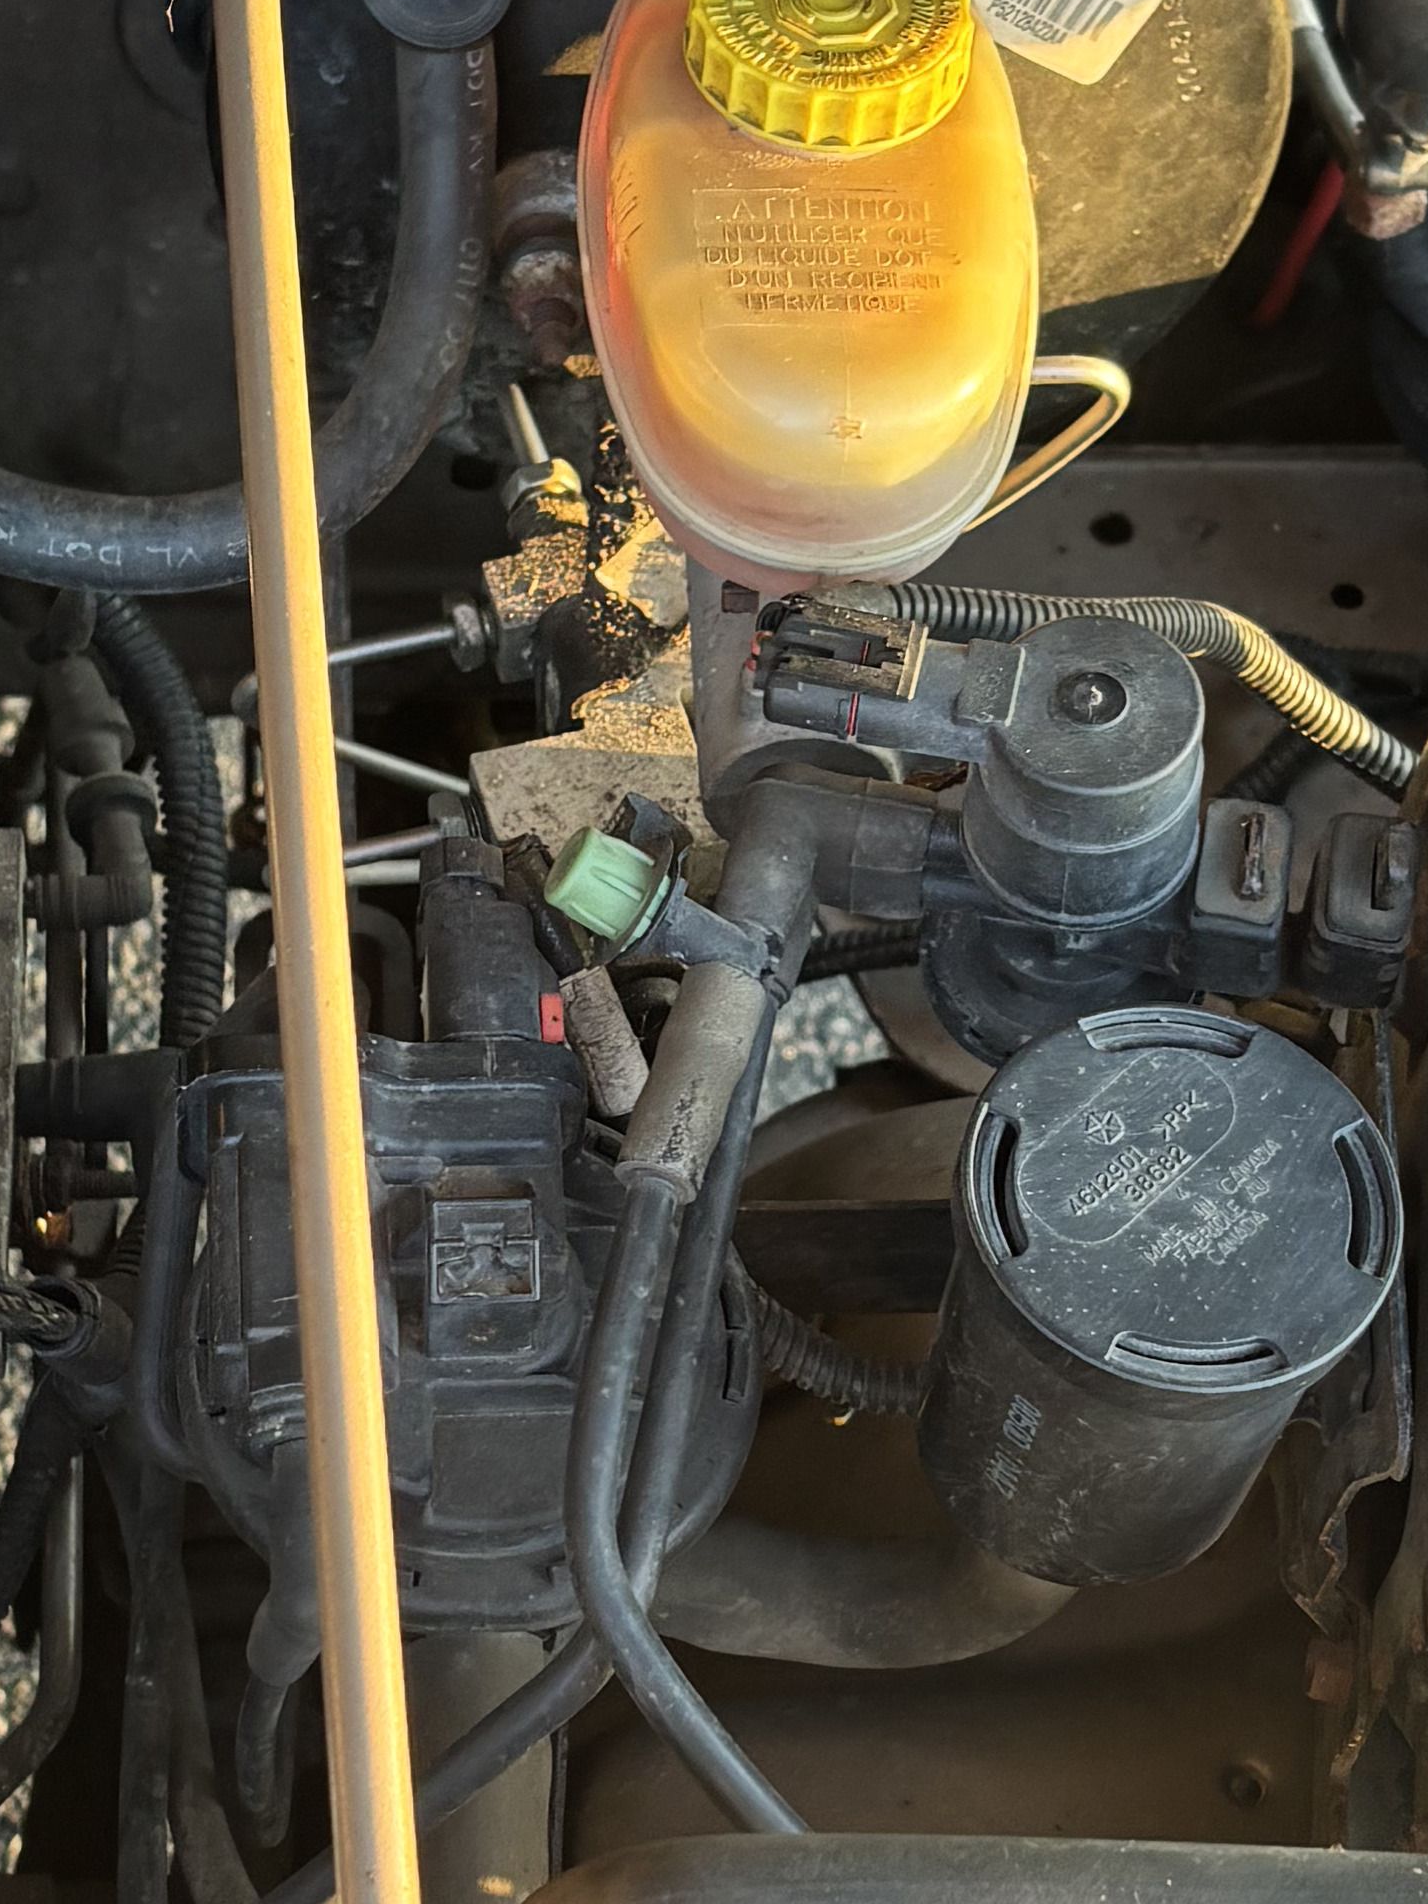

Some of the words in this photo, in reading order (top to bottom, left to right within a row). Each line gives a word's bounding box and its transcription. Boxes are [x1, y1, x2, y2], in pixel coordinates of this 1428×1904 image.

[732, 197, 931, 222] ATTENTION
[706, 247, 743, 266] DU
[757, 248, 862, 268] LIQUIDE
[876, 249, 932, 268] DOT
[887, 226, 946, 246] QUE
[38, 535, 122, 566] DOT
[1069, 1145, 1149, 1216] 4612901
[1125, 1145, 1192, 1202] 38682
[1141, 1223, 1183, 1267] MADE
[1217, 1139, 1282, 1195] CANADA
[1206, 1210, 1269, 1265] CANADA
